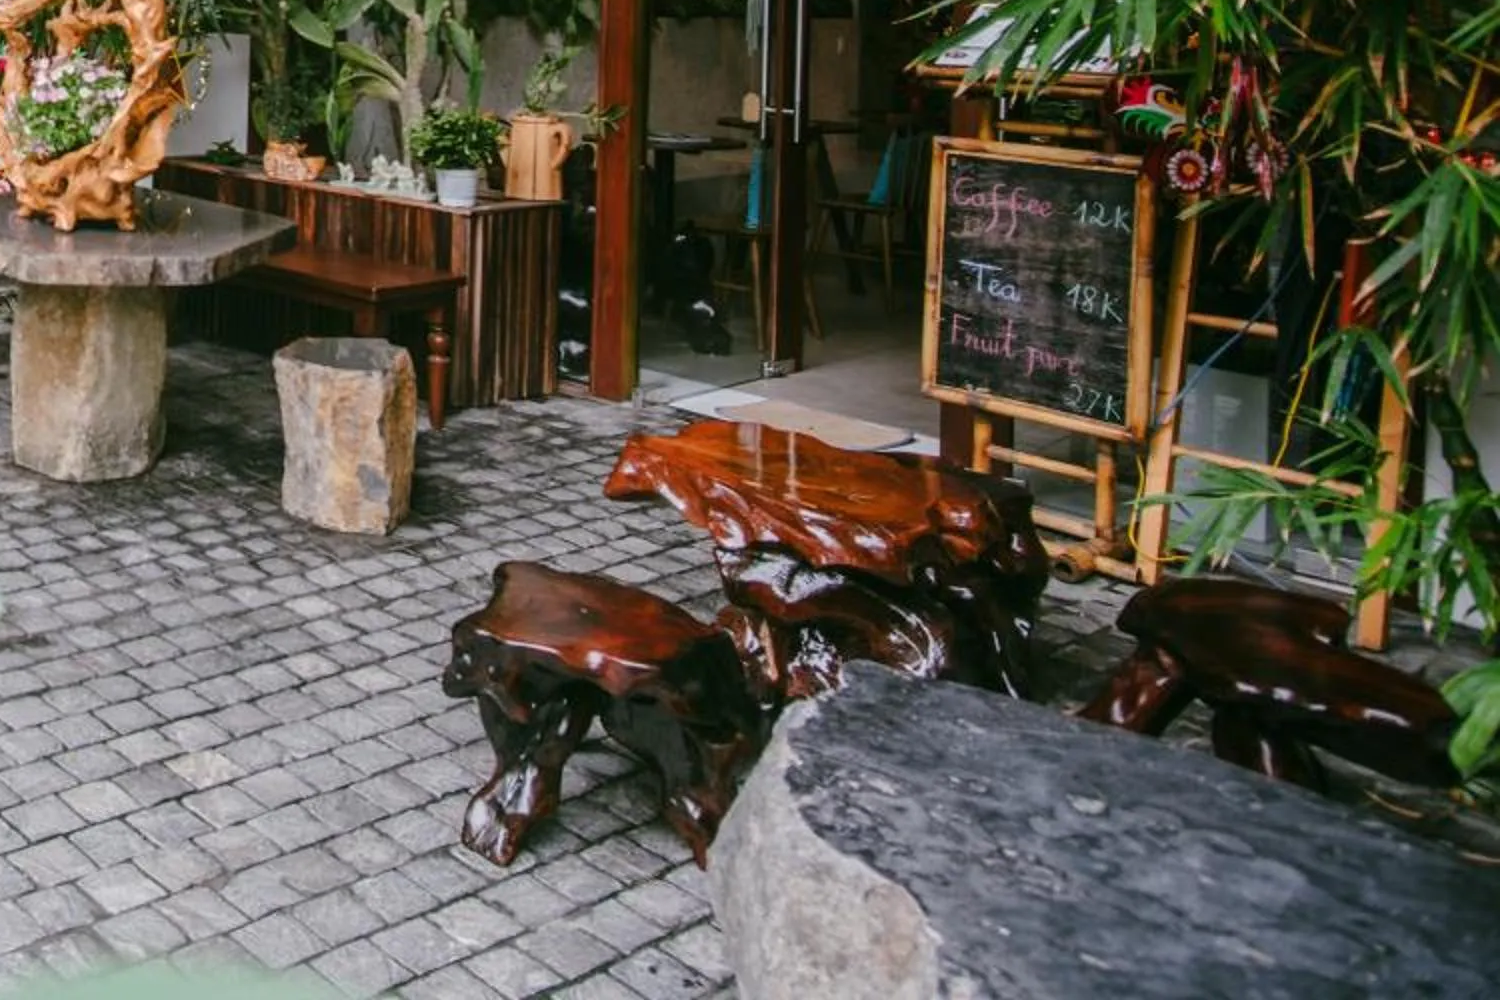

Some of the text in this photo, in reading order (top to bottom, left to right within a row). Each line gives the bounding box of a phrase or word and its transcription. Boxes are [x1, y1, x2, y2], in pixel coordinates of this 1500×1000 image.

[953, 176, 1053, 241] Coffee
[959, 259, 1021, 302] Tea
[952, 312, 1017, 359] Fruit
